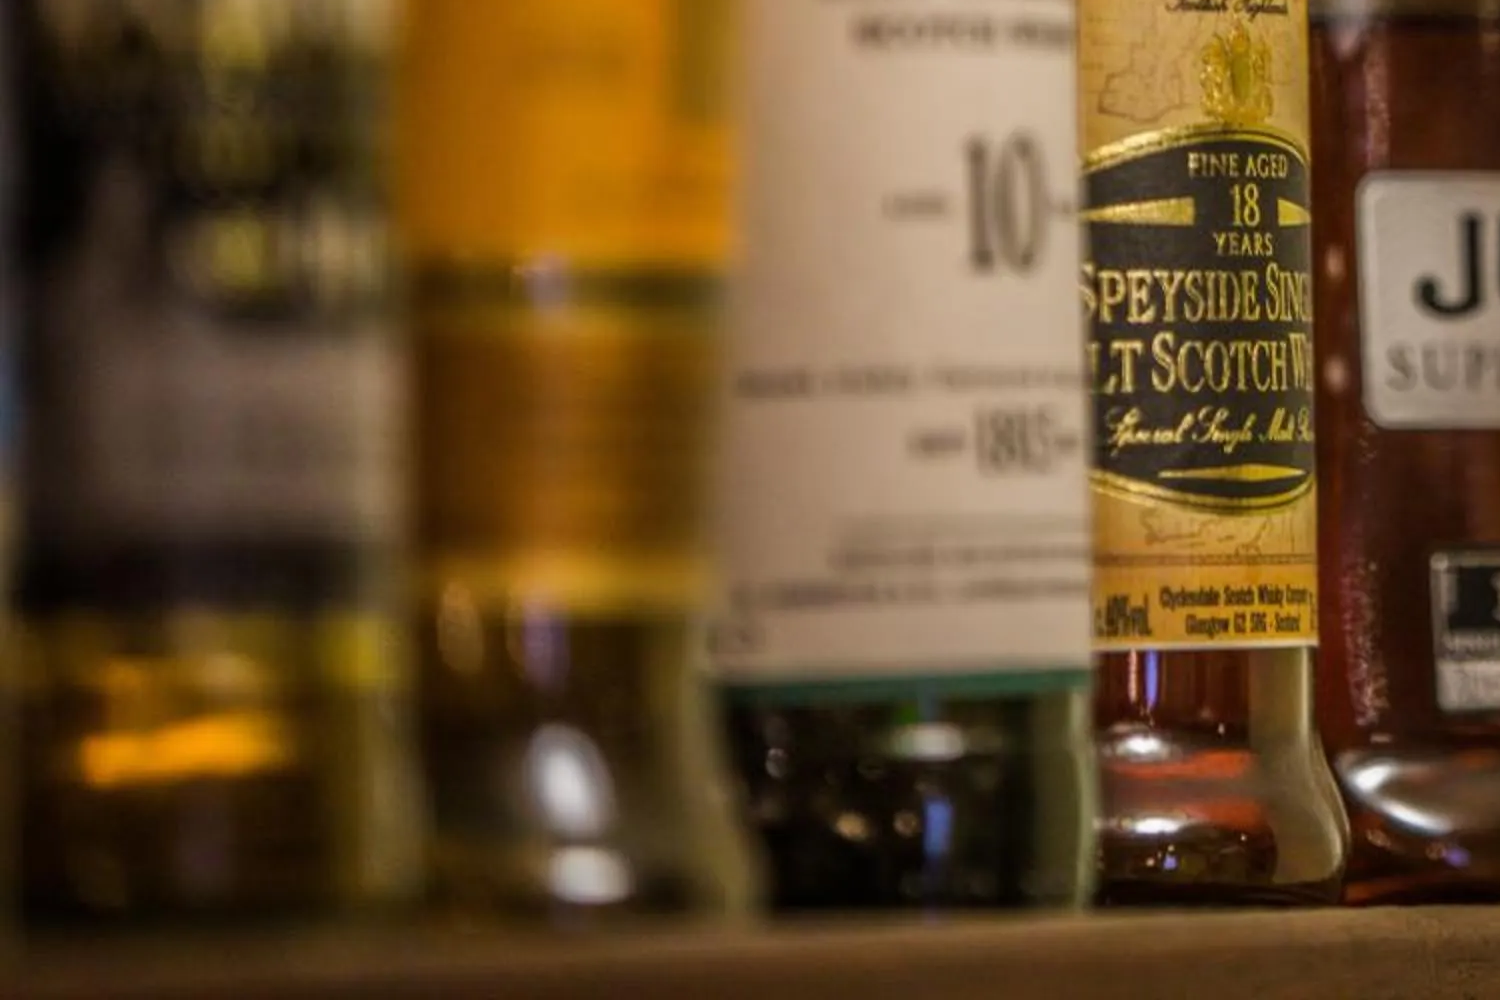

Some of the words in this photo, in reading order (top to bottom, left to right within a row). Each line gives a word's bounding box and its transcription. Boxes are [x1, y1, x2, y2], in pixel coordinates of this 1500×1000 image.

[1188, 152, 1240, 178] FINE
[1245, 152, 1289, 178] AGED
[963, 130, 1052, 275] 10
[1230, 183, 1261, 227] 18
[1213, 231, 1273, 256] YEARS
[1080, 263, 1260, 324] SPEYSIDE
[1151, 331, 1288, 393] SCOTCH
[1185, 613, 1230, 639] Glasgow
